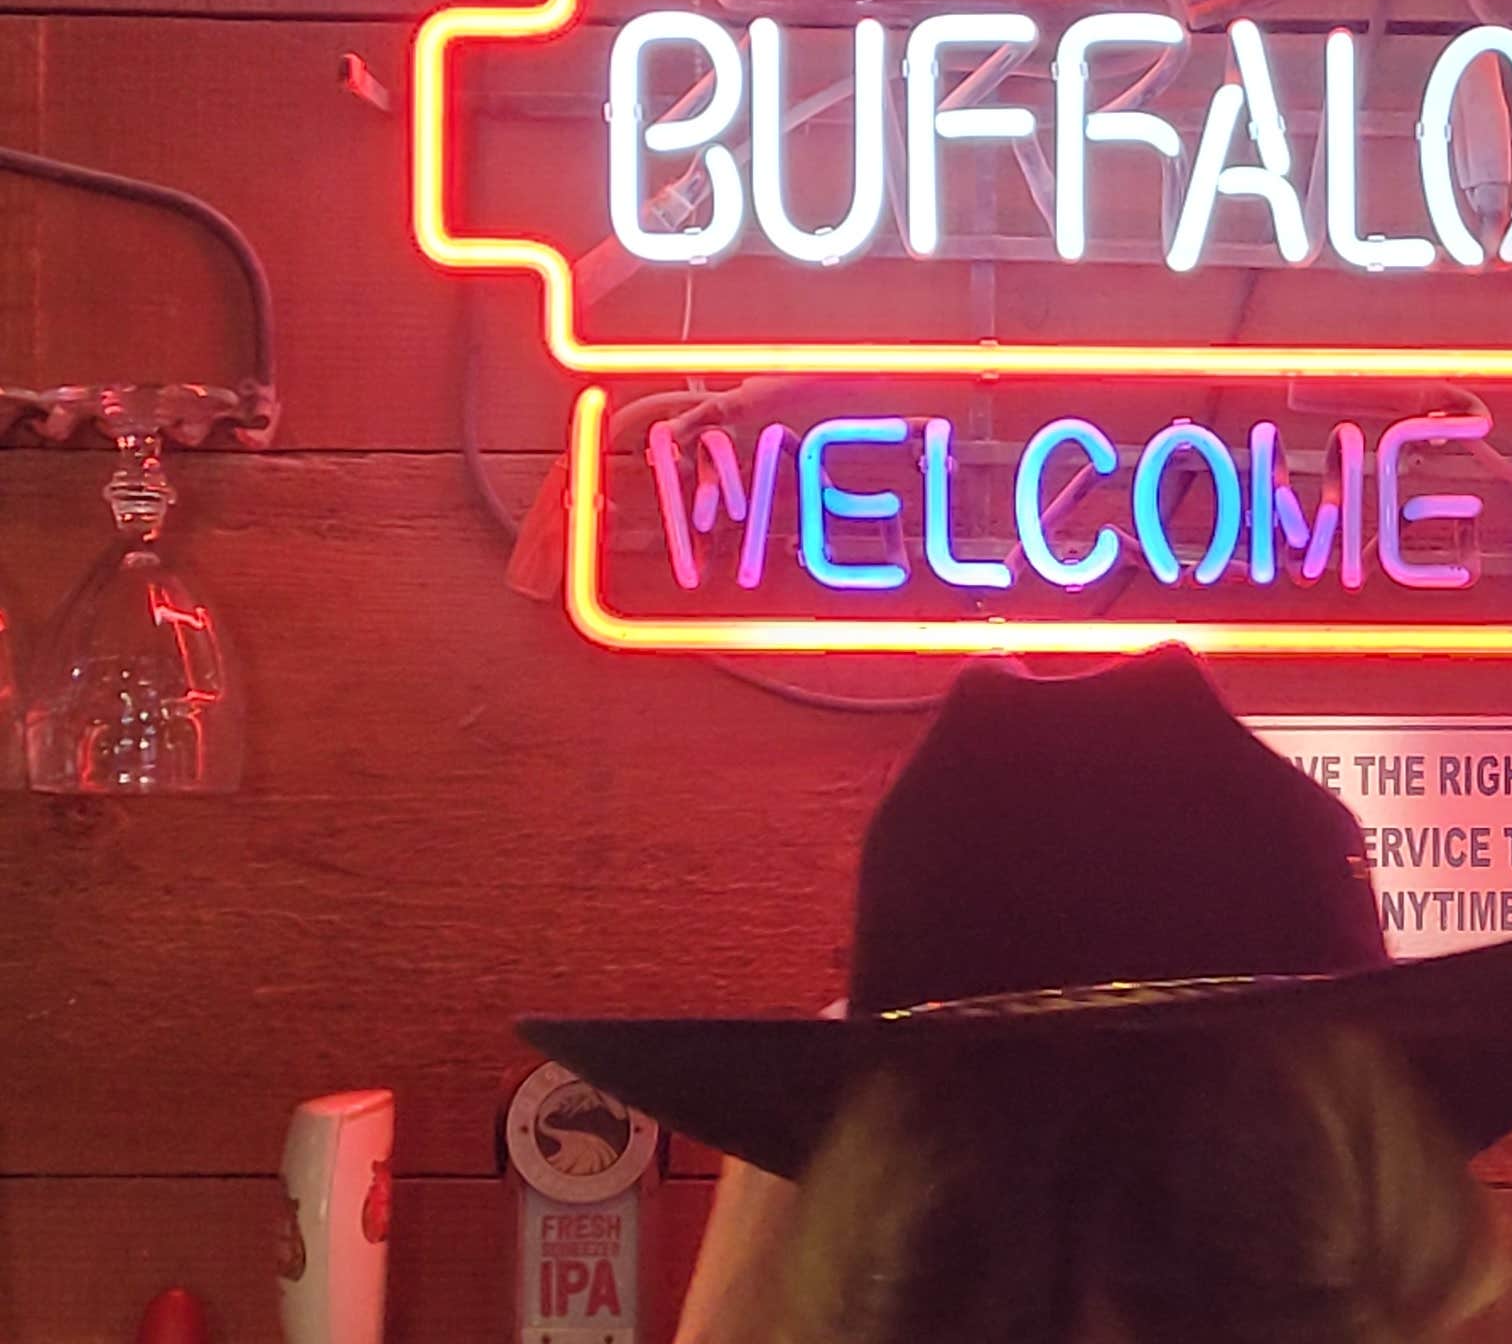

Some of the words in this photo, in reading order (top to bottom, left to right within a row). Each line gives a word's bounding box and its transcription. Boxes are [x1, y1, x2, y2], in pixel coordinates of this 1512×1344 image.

[649, 414, 1491, 591] WELCOME
[1294, 755, 1341, 796] VE
[1355, 756, 1425, 796] THE
[1364, 827, 1491, 867] ERVICE
[542, 1215, 621, 1241] FRESH
[541, 1259, 622, 1317] IPA
